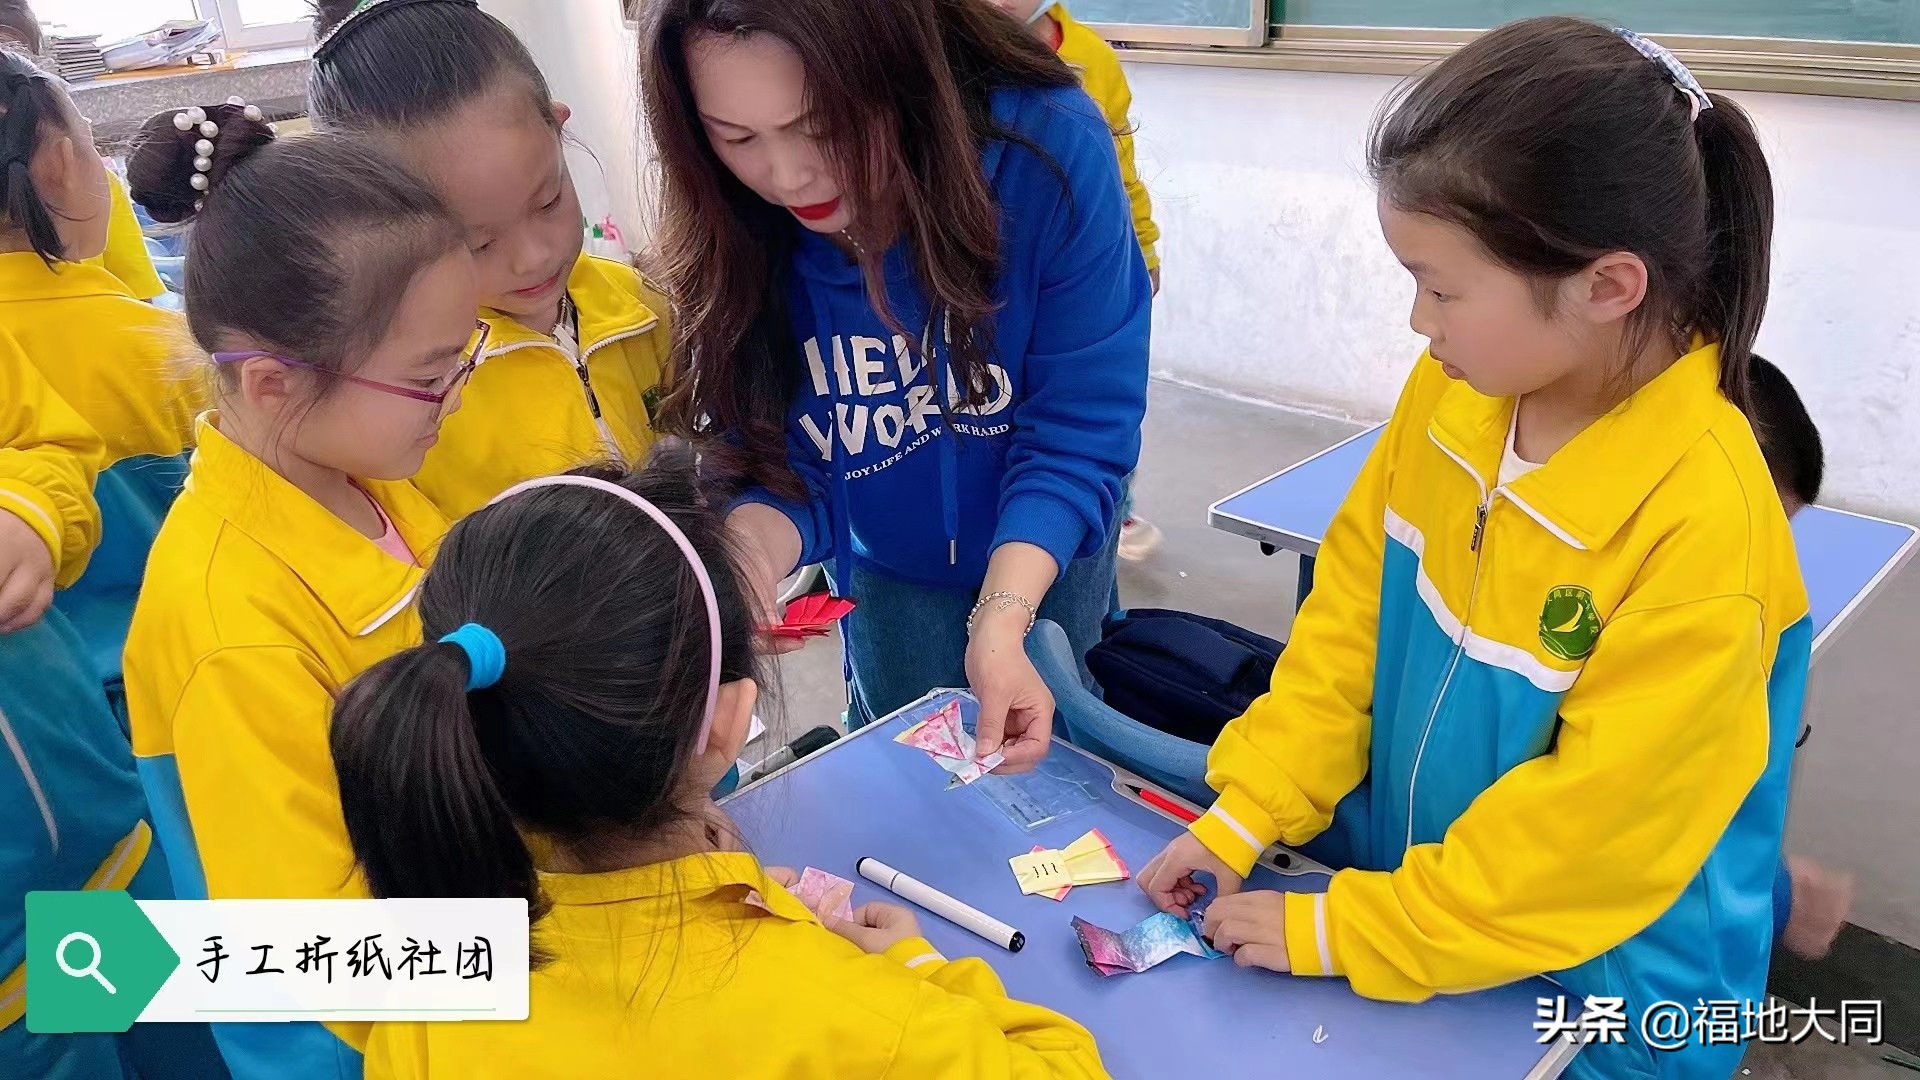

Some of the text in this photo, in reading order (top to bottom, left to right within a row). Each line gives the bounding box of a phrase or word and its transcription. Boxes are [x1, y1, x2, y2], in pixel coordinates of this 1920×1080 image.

[804, 304, 974, 396] HEL
[844, 423, 1010, 480] JOY LIFE AND WRK HARD
